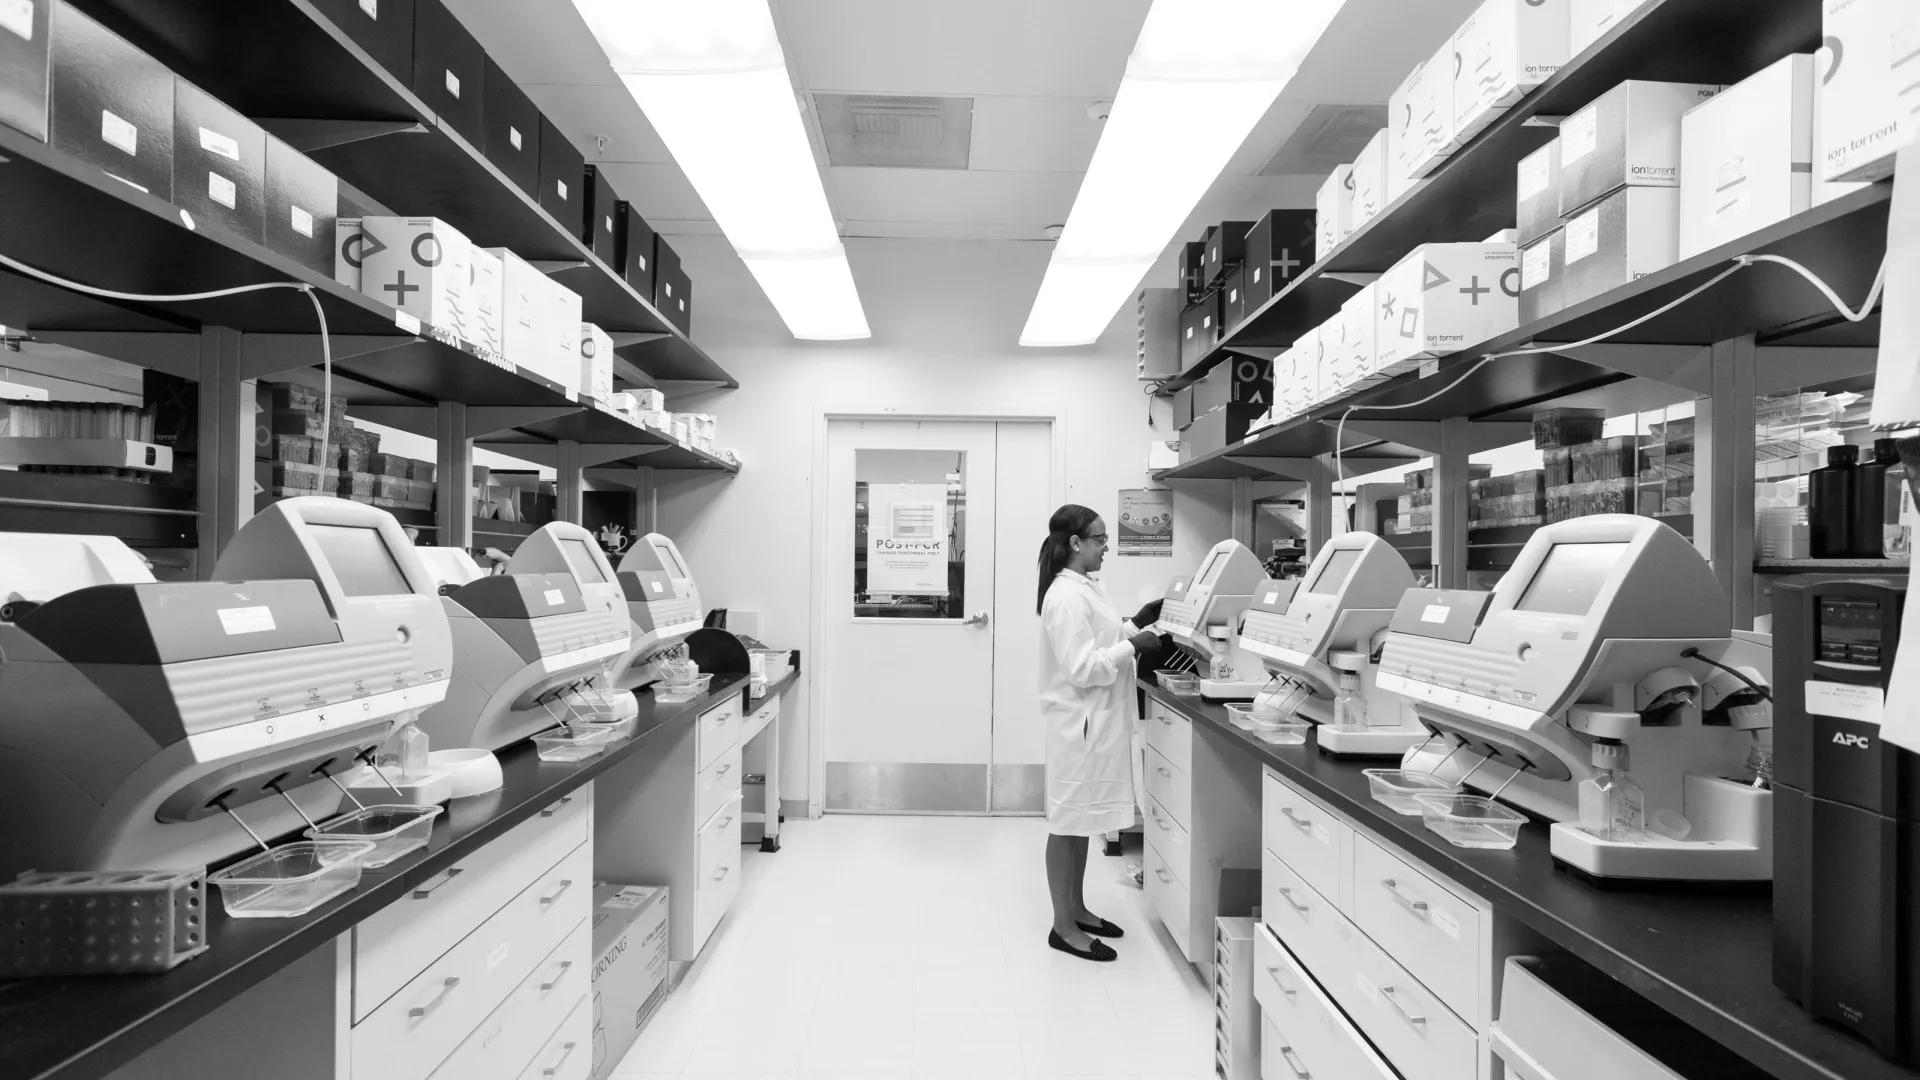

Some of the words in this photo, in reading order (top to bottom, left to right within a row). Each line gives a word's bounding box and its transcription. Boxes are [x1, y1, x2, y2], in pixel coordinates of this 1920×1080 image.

[1524, 64, 1537, 72] ion
[1827, 146, 1846, 161] ion
[1850, 121, 1898, 151] torrent
[1832, 732, 1869, 749] APC
[591, 935, 627, 983] ORNING
